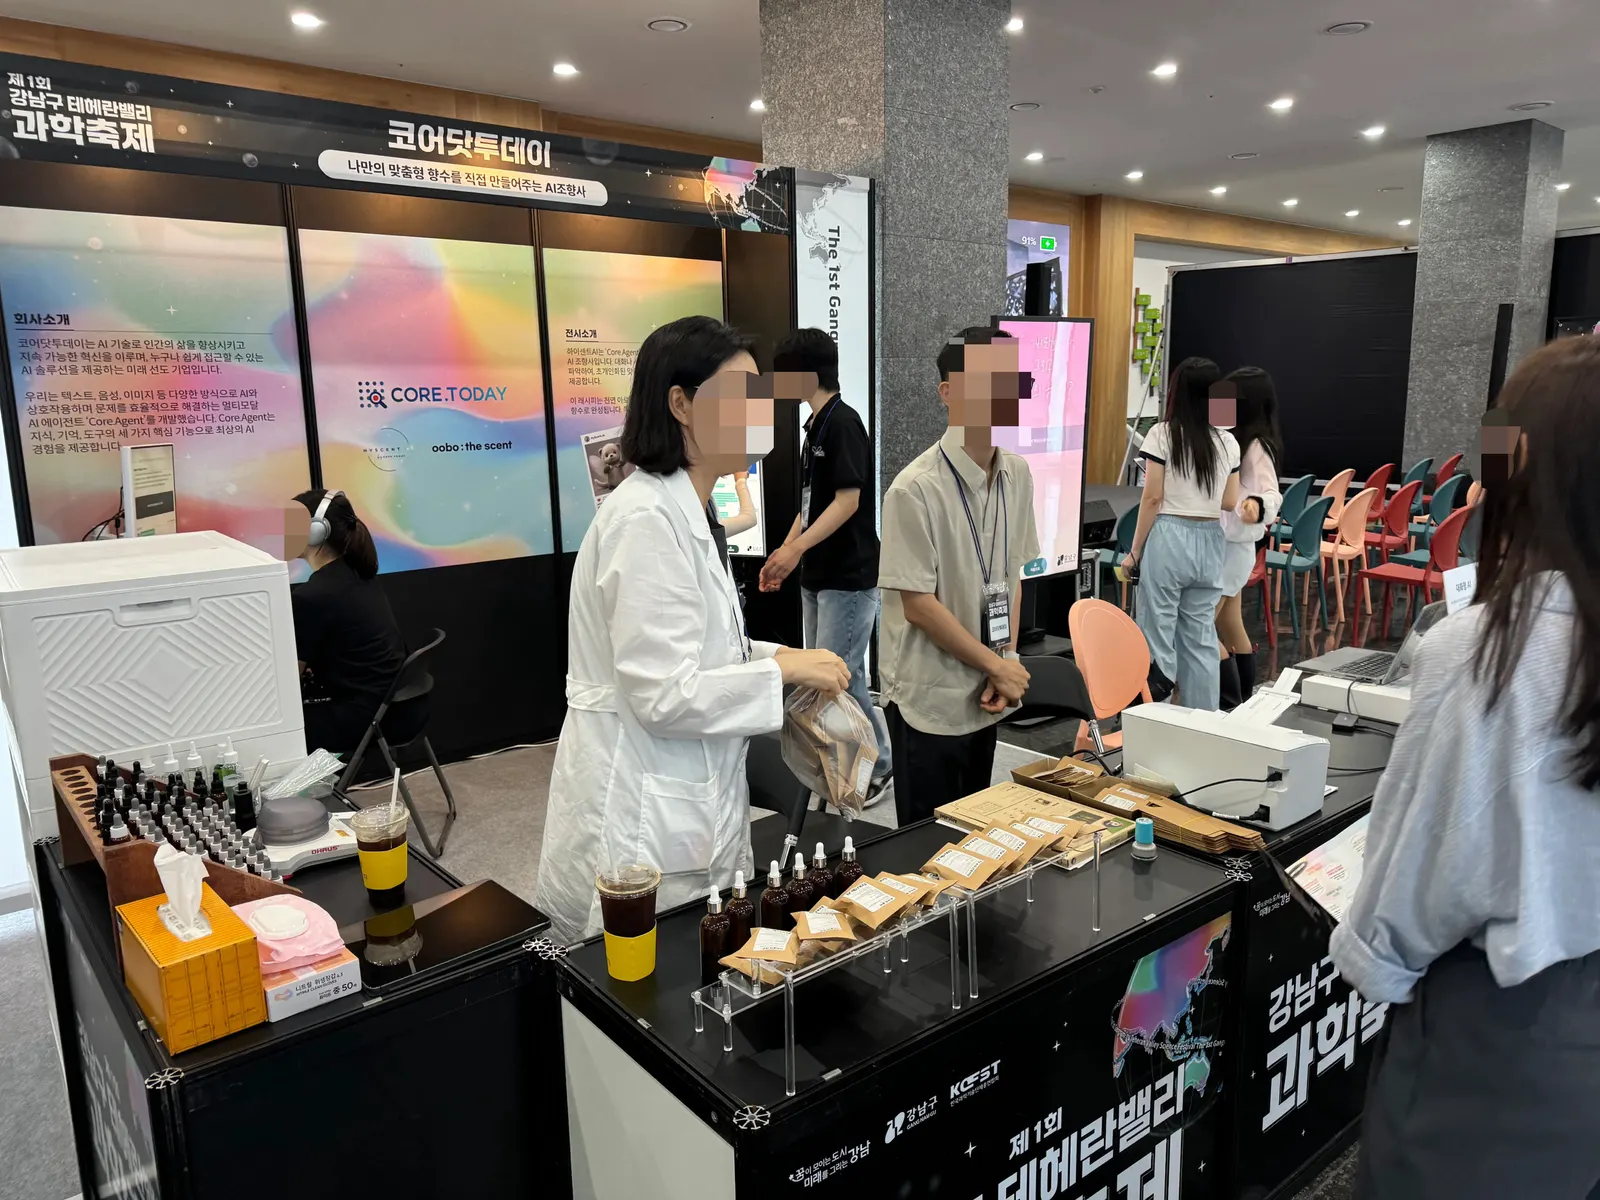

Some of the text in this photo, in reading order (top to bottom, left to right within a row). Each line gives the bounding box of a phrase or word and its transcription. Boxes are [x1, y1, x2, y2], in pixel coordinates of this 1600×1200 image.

[7, 72, 51, 91] 제 1회
[9, 88, 152, 122] 강남구 테헤란밸리
[11, 108, 155, 154] 과학축제
[388, 119, 551, 169] 코어닷투데이
[348, 159, 586, 198] 나만의 맞춤형 향수를 직접 만들어주는 AI조향사
[1021, 236, 1036, 246] 91%
[828, 225, 841, 341] The 1st Gang
[14, 313, 70, 325] 회사소개
[565, 328, 597, 339] 전시소개
[18, 338, 246, 350] 코어닷투데이는 AI 기술로 인간의 삶을 향상시키고
[19, 351, 264, 363] 지속 가능한 혁신을 이루며, 누구나 쉽게 접근할 수 있는
[21, 364, 222, 375] AI 솔루션을 제공하는 미래 선도 기업입니다.
[25, 388, 258, 402] 우리는 텍스트, 음성, 이미지 등 다양한 방식으로 AI와
[391, 387, 508, 402] CORE.TODAY
[27, 400, 259, 415] 상호작용하며 문제를 효율적으로 해결하는 멀티모달
[28, 418, 39, 428] AI
[41, 417, 85, 428] 에이전트
[158, 413, 217, 424] 개발했습니다.
[31, 424, 255, 442] 지식, 기억, 도구의 세 가지 핵심 기능으로 최상의 AI
[33, 443, 65, 455] 경험을
[432, 444, 460, 453] oobo
[465, 442, 483, 451] the
[484, 440, 513, 451] scent
[311, 845, 338, 854] OHAUS
[906, 1095, 938, 1122] 강남구
[1009, 1107, 1062, 1160] 제 1회
[831, 1145, 848, 1162] 도시
[848, 1139, 871, 1163] 강남
